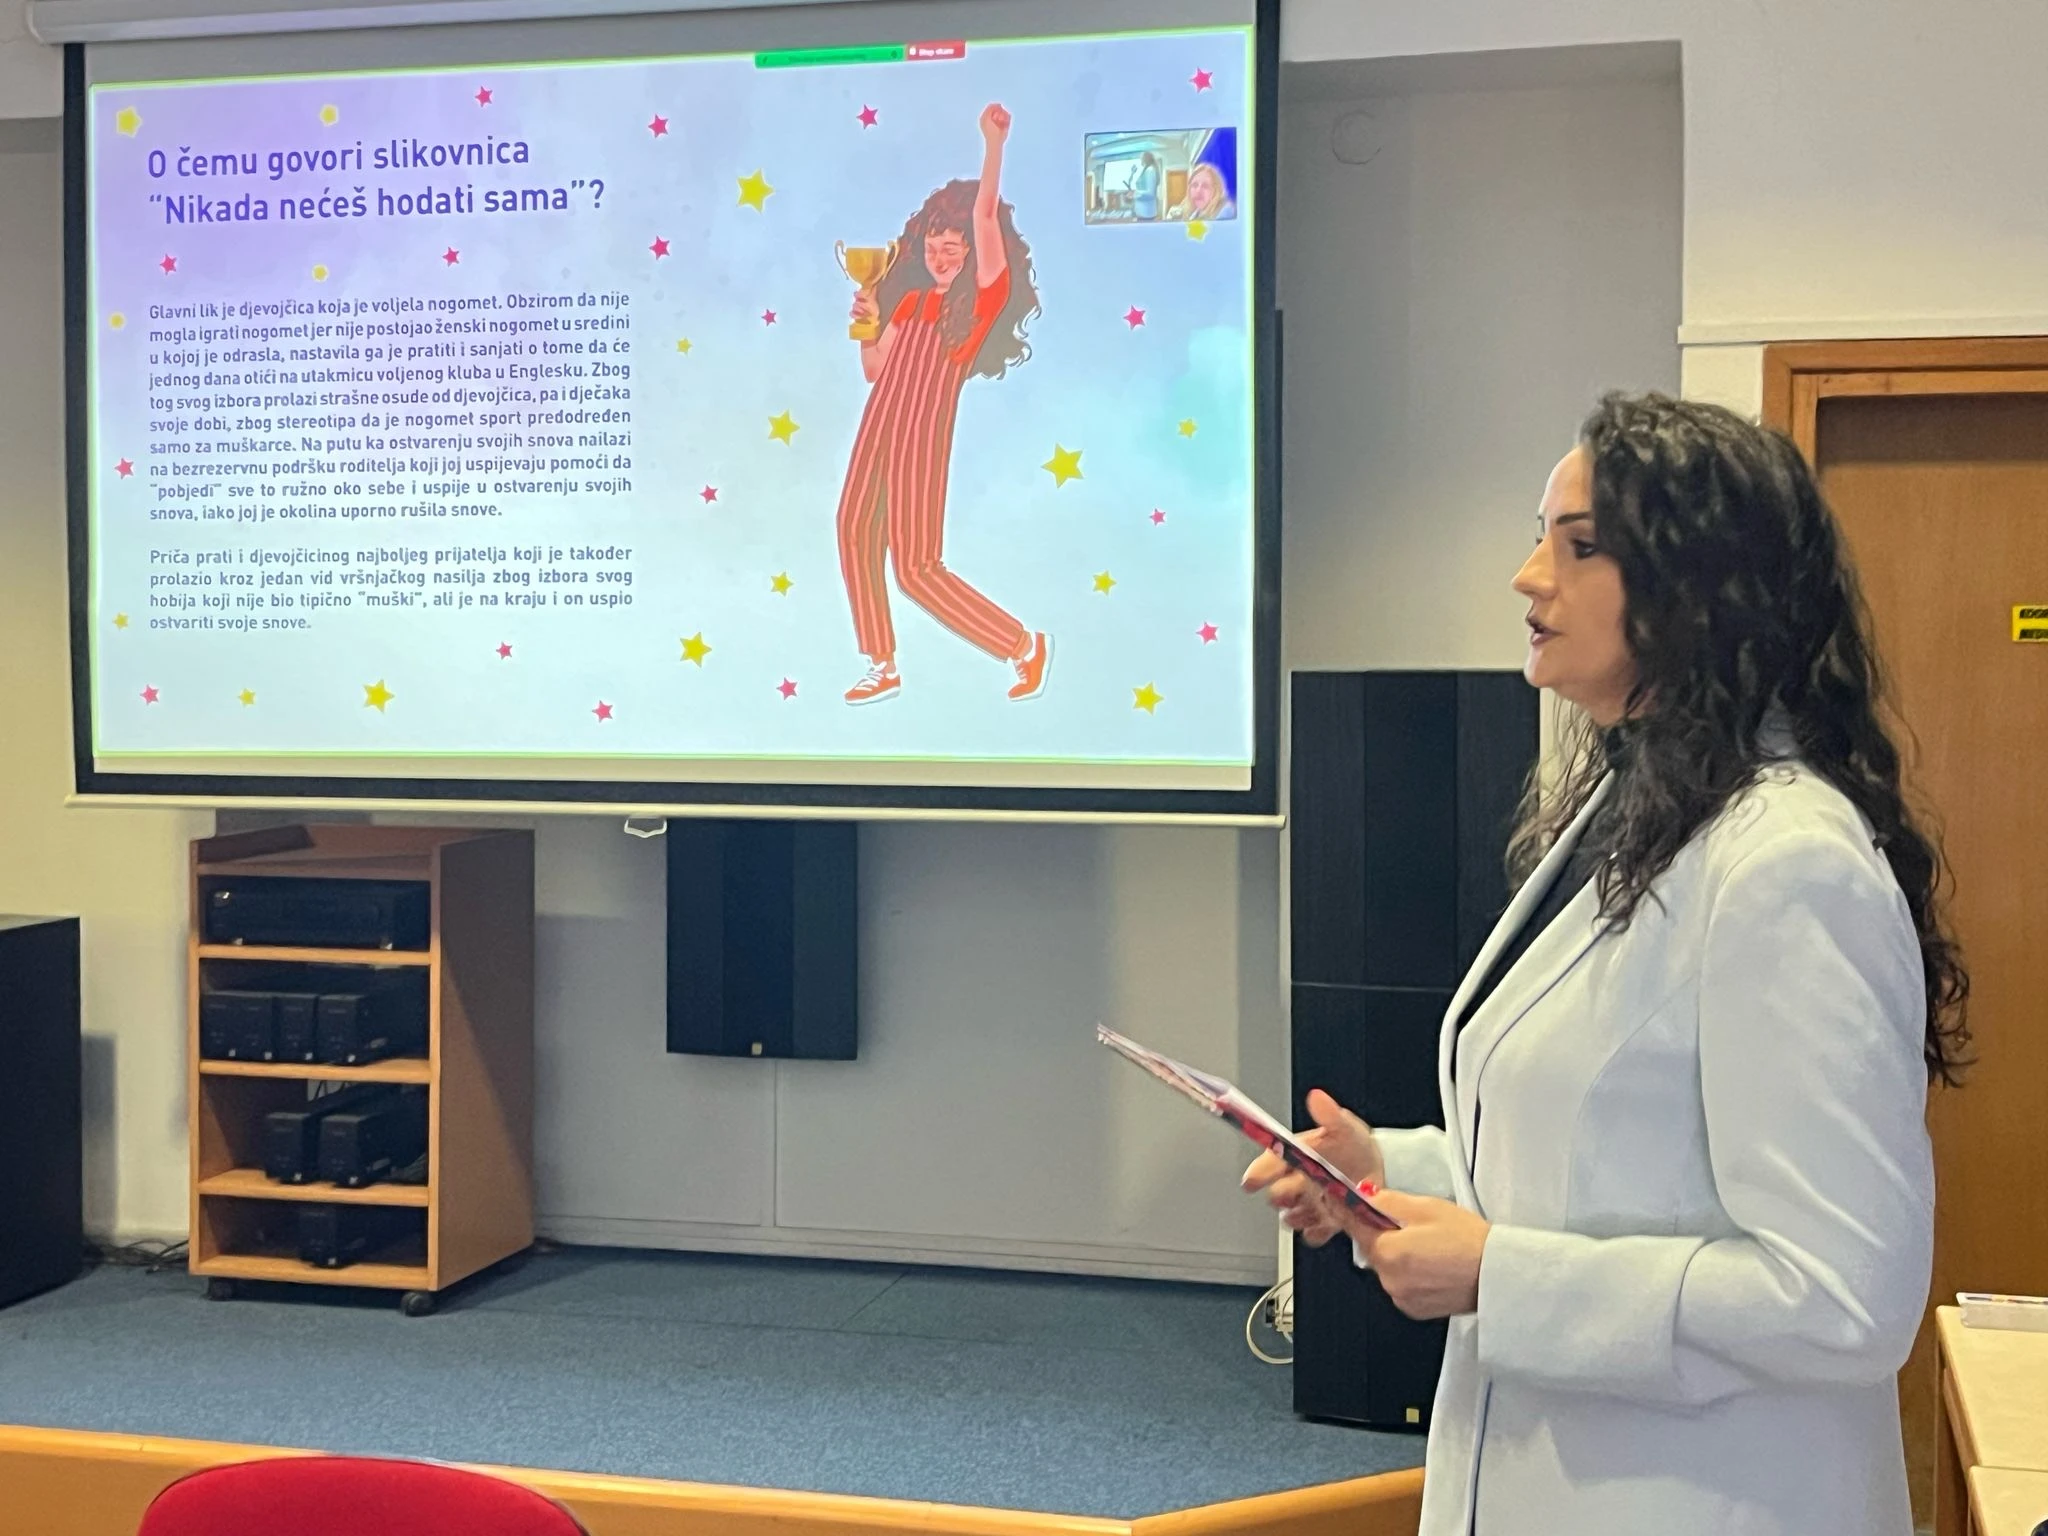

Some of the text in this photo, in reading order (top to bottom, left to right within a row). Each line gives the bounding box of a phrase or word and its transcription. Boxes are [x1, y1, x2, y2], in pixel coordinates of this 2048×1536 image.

[148, 135, 529, 181] O čemu govori slikovnica
[280, 186, 367, 220] nećeš
[378, 183, 473, 216] hodati
[149, 290, 630, 321] Glavni lik je djevojčica koja je voljela nogomet. Obzirom da nije
[149, 314, 630, 345] mogla igrati nogomet jer nije postojao ženski nogomet u sredini
[149, 337, 631, 368] u kojoj je odrasla, nastavila ga je pratiti i sanjati o tome da će
[149, 361, 630, 391] jednog dana otići na utakmicu voljenog kluba u Englesku. Zbog
[149, 396, 173, 413] tog
[176, 397, 211, 412] svog
[214, 393, 261, 408] izbora
[264, 391, 317, 411] prolazi
[320, 389, 379, 406] strašne
[382, 389, 429, 404] osude
[431, 388, 451, 403] od
[540, 389, 559, 405] pa
[561, 386, 566, 401] i
[569, 384, 631, 405] dječaka
[149, 408, 631, 435] svoje dobi, zbog stereotipa da je nogomet sport predodređen
[150, 442, 191, 454] samo
[195, 442, 212, 454] za
[301, 436, 322, 451] Na
[326, 437, 362, 454] putu
[366, 435, 384, 450] ka
[389, 433, 472, 452] ostvarenju
[476, 433, 523, 452] svojih
[527, 435, 574, 447] snova
[578, 431, 631, 447] nailazi
[150, 453, 632, 478] na bezrezervnu podršku roditelja koji joj uspijevaju pomoći da
[228, 486, 255, 497] sve
[260, 483, 276, 497] to
[282, 480, 327, 497] ružno
[333, 481, 361, 496] oko
[368, 480, 405, 495] sebe
[412, 480, 416, 495] i
[423, 479, 470, 498] uspije
[477, 482, 487, 494] u
[494, 478, 578, 496] ostvarenju
[585, 477, 632, 496] svojih
[150, 501, 503, 523] snova, iako joj je okolina uporno rušila snove.
[150, 545, 633, 568] Priča prati i djevojčicinog najboljeg prijatelja koji je također
[150, 568, 633, 589] prolazio kroz jedan vid vršnjačkog nasilja zbog izbora svog
[150, 593, 196, 611] hobija
[202, 593, 230, 611] koji
[236, 593, 265, 611] nije
[271, 593, 294, 607] bio
[300, 591, 352, 610] tipično
[433, 591, 453, 606] ali
[458, 591, 473, 610] je
[479, 594, 499, 606] na
[505, 590, 546, 609] kraju
[553, 591, 557, 606] i
[563, 594, 583, 605] on
[589, 590, 633, 609] uspio
[150, 615, 312, 633] ostvariti svoje snove.
